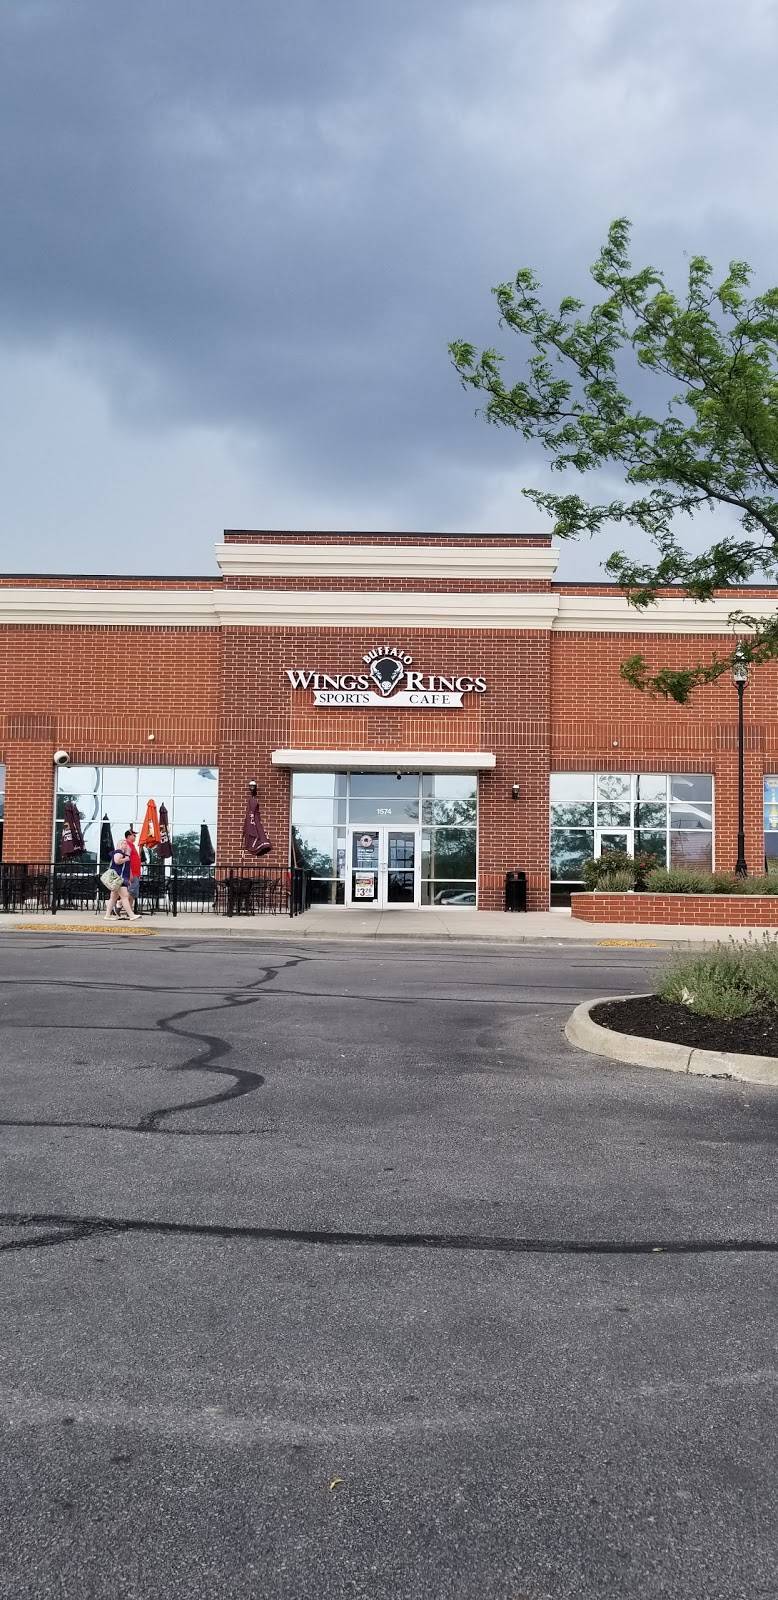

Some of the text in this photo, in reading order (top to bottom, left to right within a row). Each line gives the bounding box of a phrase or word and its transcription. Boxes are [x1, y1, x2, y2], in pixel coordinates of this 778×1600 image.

[362, 646, 413, 665] BUFFALO
[286, 670, 487, 692] WINGS RINGS
[319, 693, 451, 704] SPORTS CAFE
